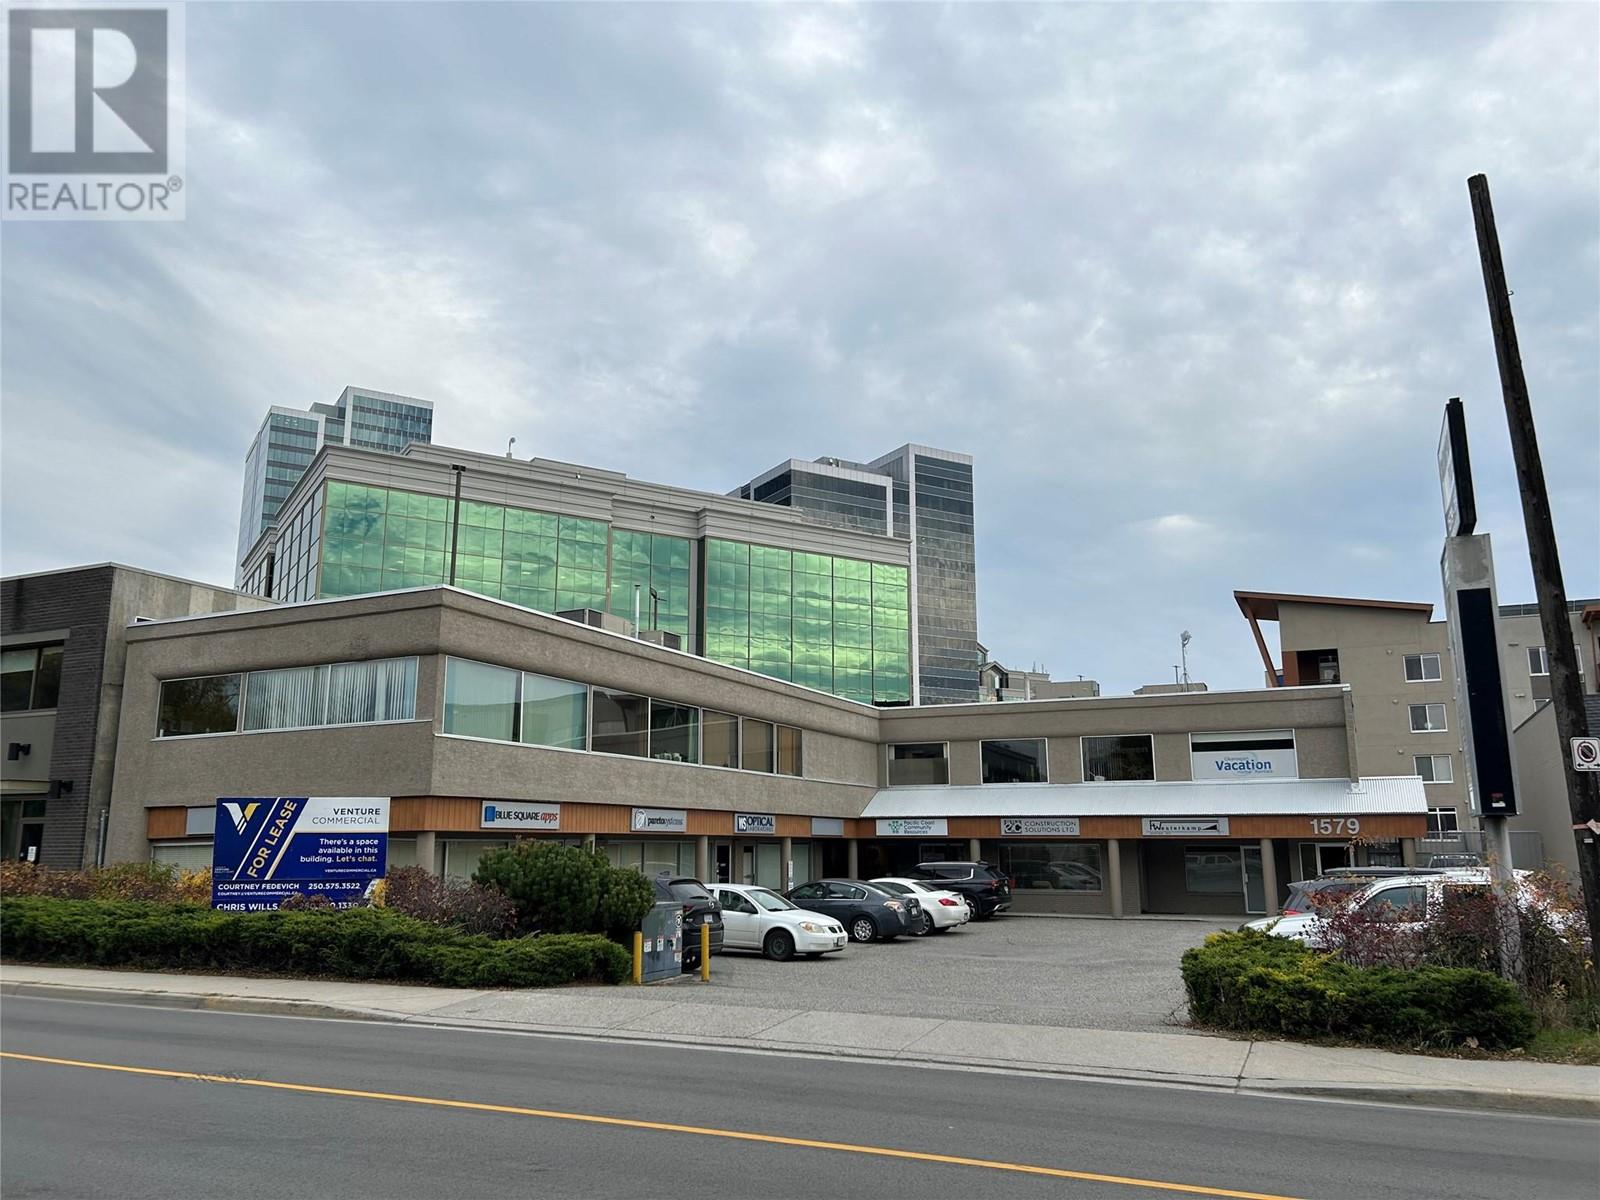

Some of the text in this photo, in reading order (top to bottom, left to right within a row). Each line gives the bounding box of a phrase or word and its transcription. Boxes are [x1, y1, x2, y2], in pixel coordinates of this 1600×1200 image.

[1215, 759, 1271, 771] Vacation
[333, 808, 381, 816] VENTURE
[312, 816, 380, 825] COMMERCIAL
[496, 810, 558, 824] BLUE SQUARE apps
[747, 816, 774, 827] OPTICAL
[1310, 818, 1360, 835] 1579
[246, 799, 298, 878] FOR LEASE
[356, 839, 379, 847] space
[318, 846, 379, 854] available in this
[300, 855, 335, 863] building.
[308, 882, 361, 890] 250.575.3522
[216, 903, 246, 911] CHRIS
[248, 903, 278, 911] WILLS
